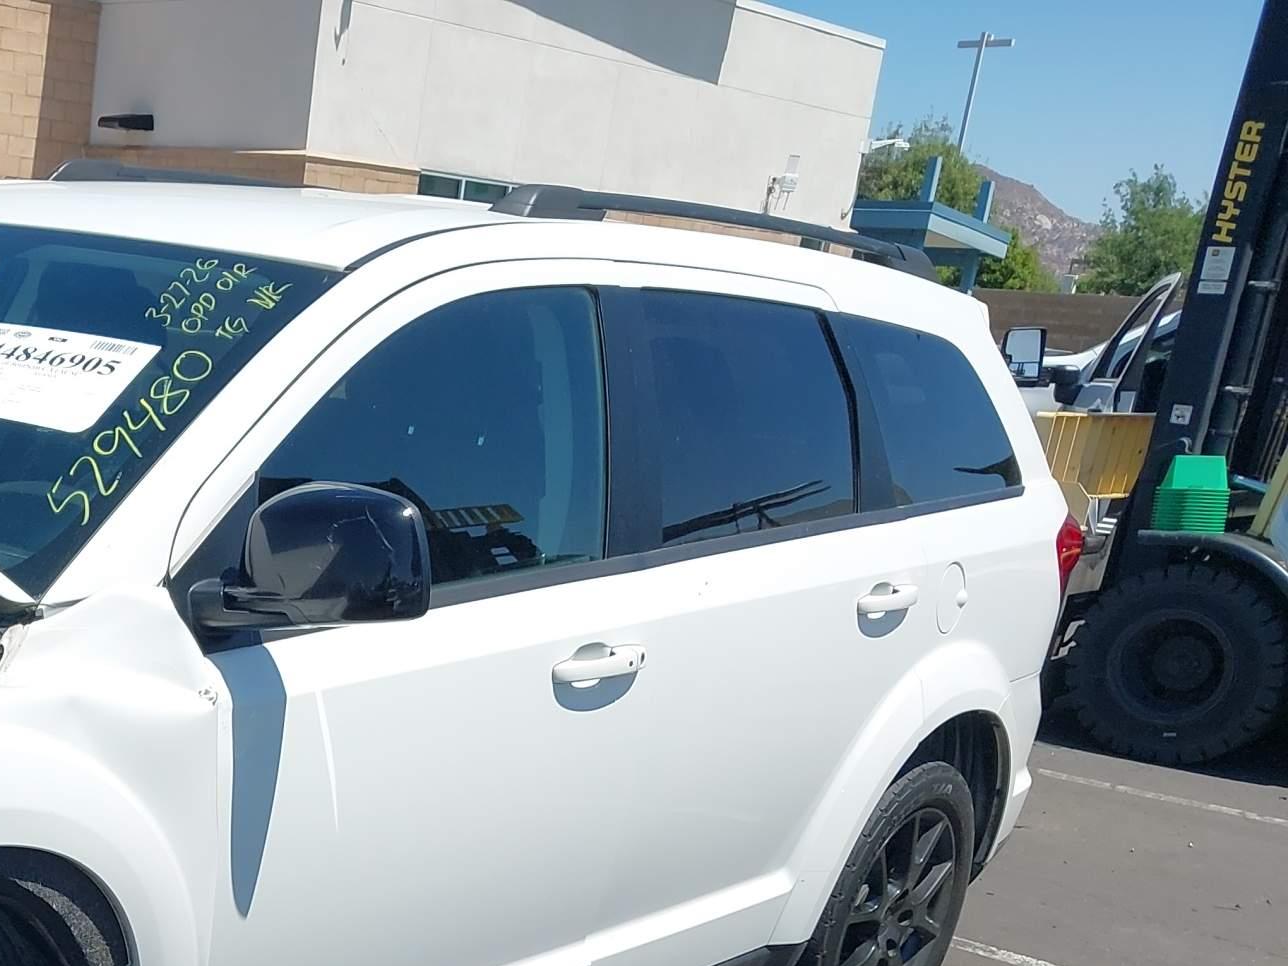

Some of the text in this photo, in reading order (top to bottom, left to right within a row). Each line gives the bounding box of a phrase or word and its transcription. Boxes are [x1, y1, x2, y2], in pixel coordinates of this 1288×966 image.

[1212, 120, 1265, 243] HYSTER
[145, 258, 219, 327] 3-27-26
[47, 350, 213, 526] 529480
